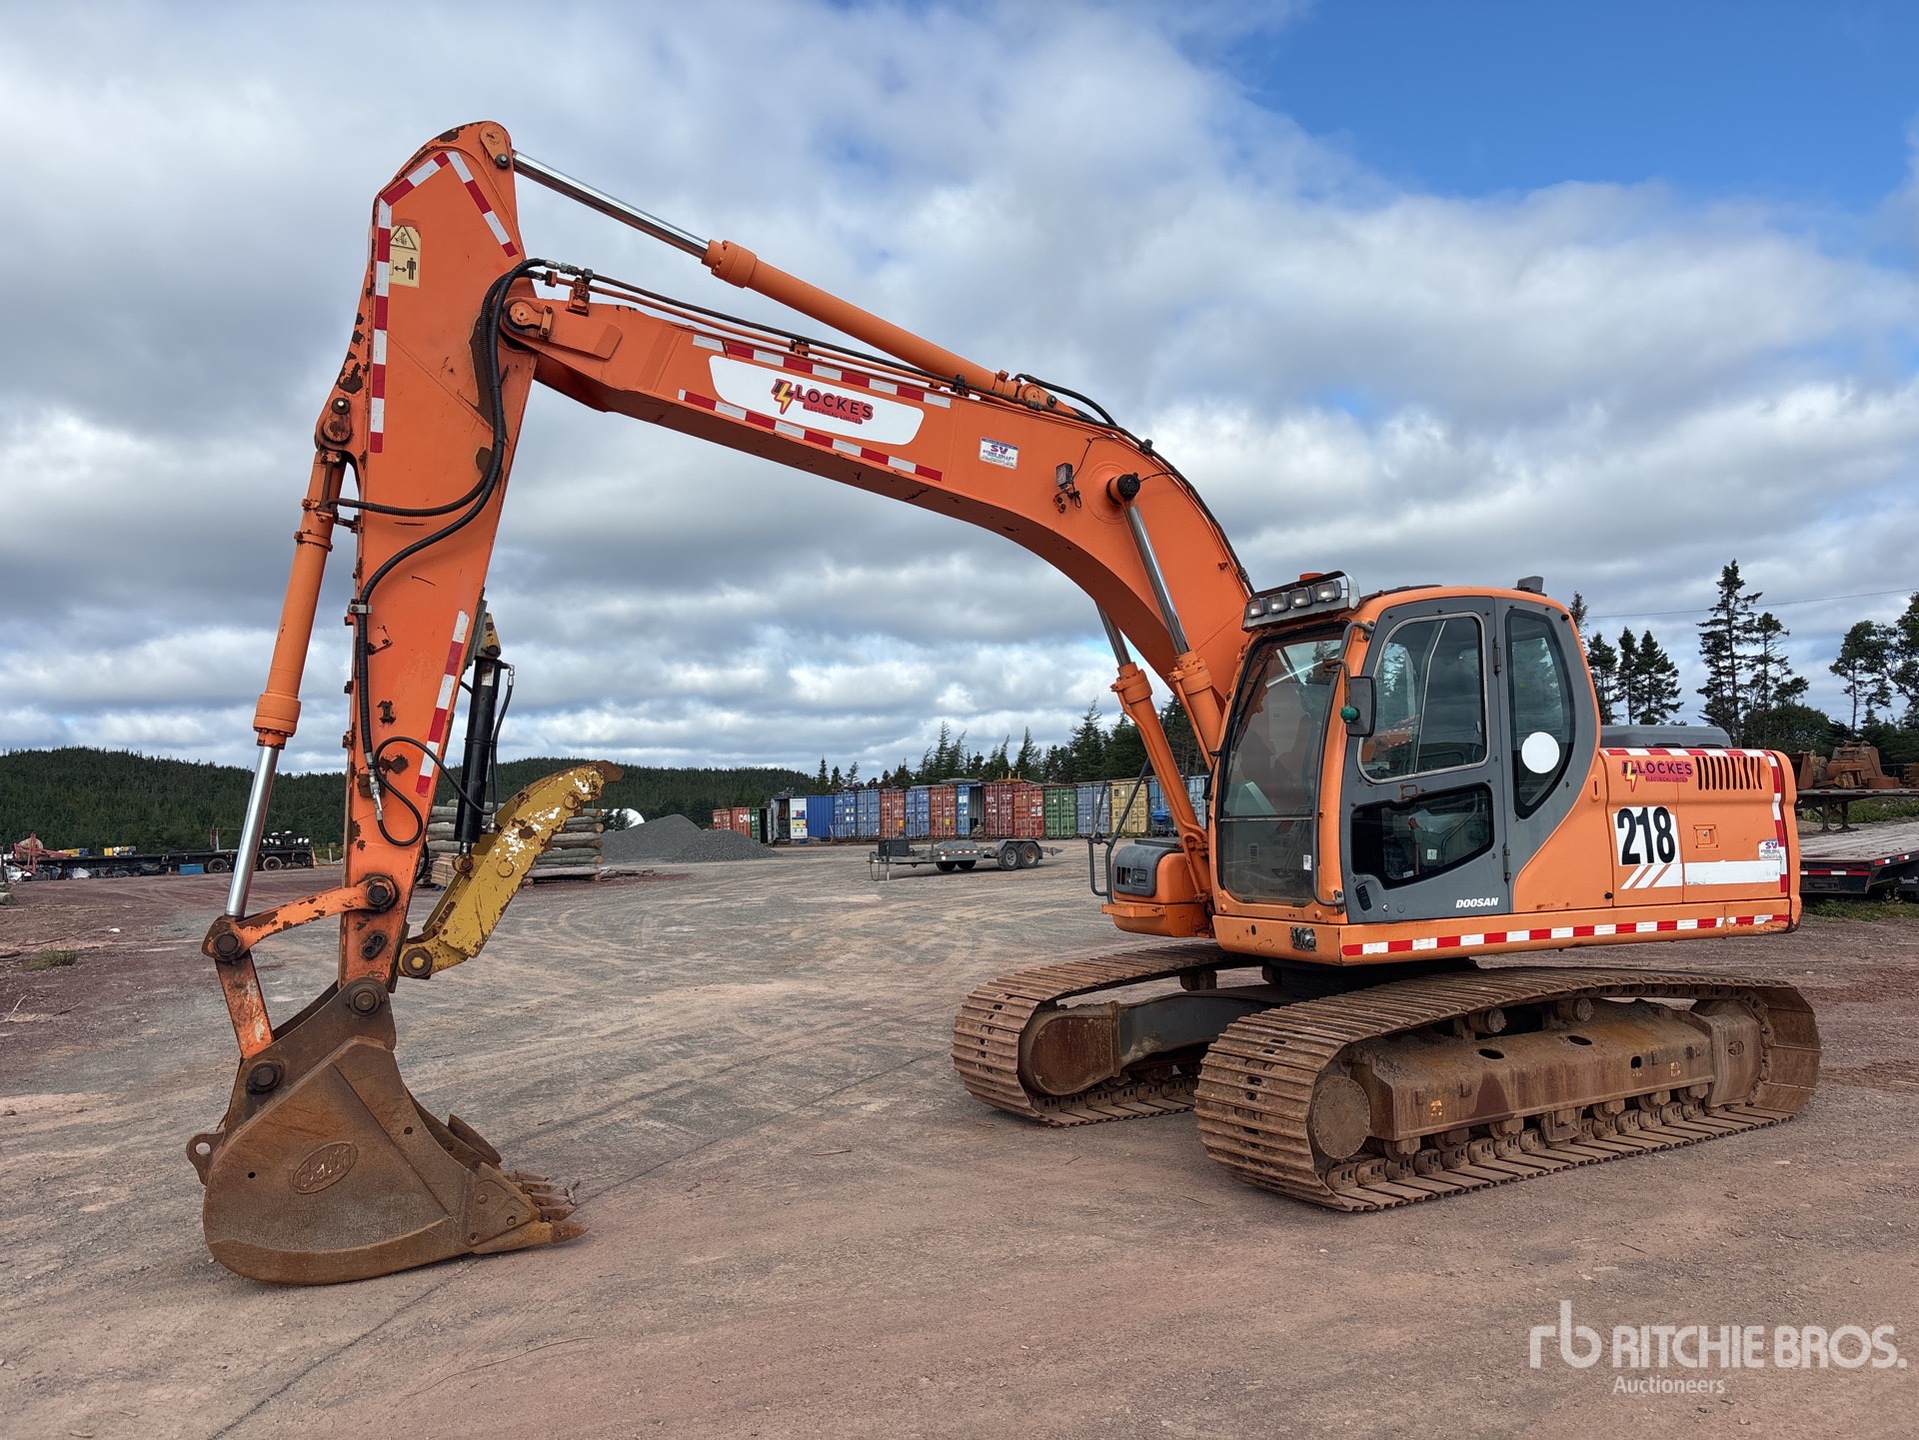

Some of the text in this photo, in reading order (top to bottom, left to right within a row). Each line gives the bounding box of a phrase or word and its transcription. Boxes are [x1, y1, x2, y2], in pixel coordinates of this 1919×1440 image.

[990, 444, 1009, 455] SV
[1617, 806, 1676, 866] 218
[1455, 896, 1499, 909] DOOSAN
